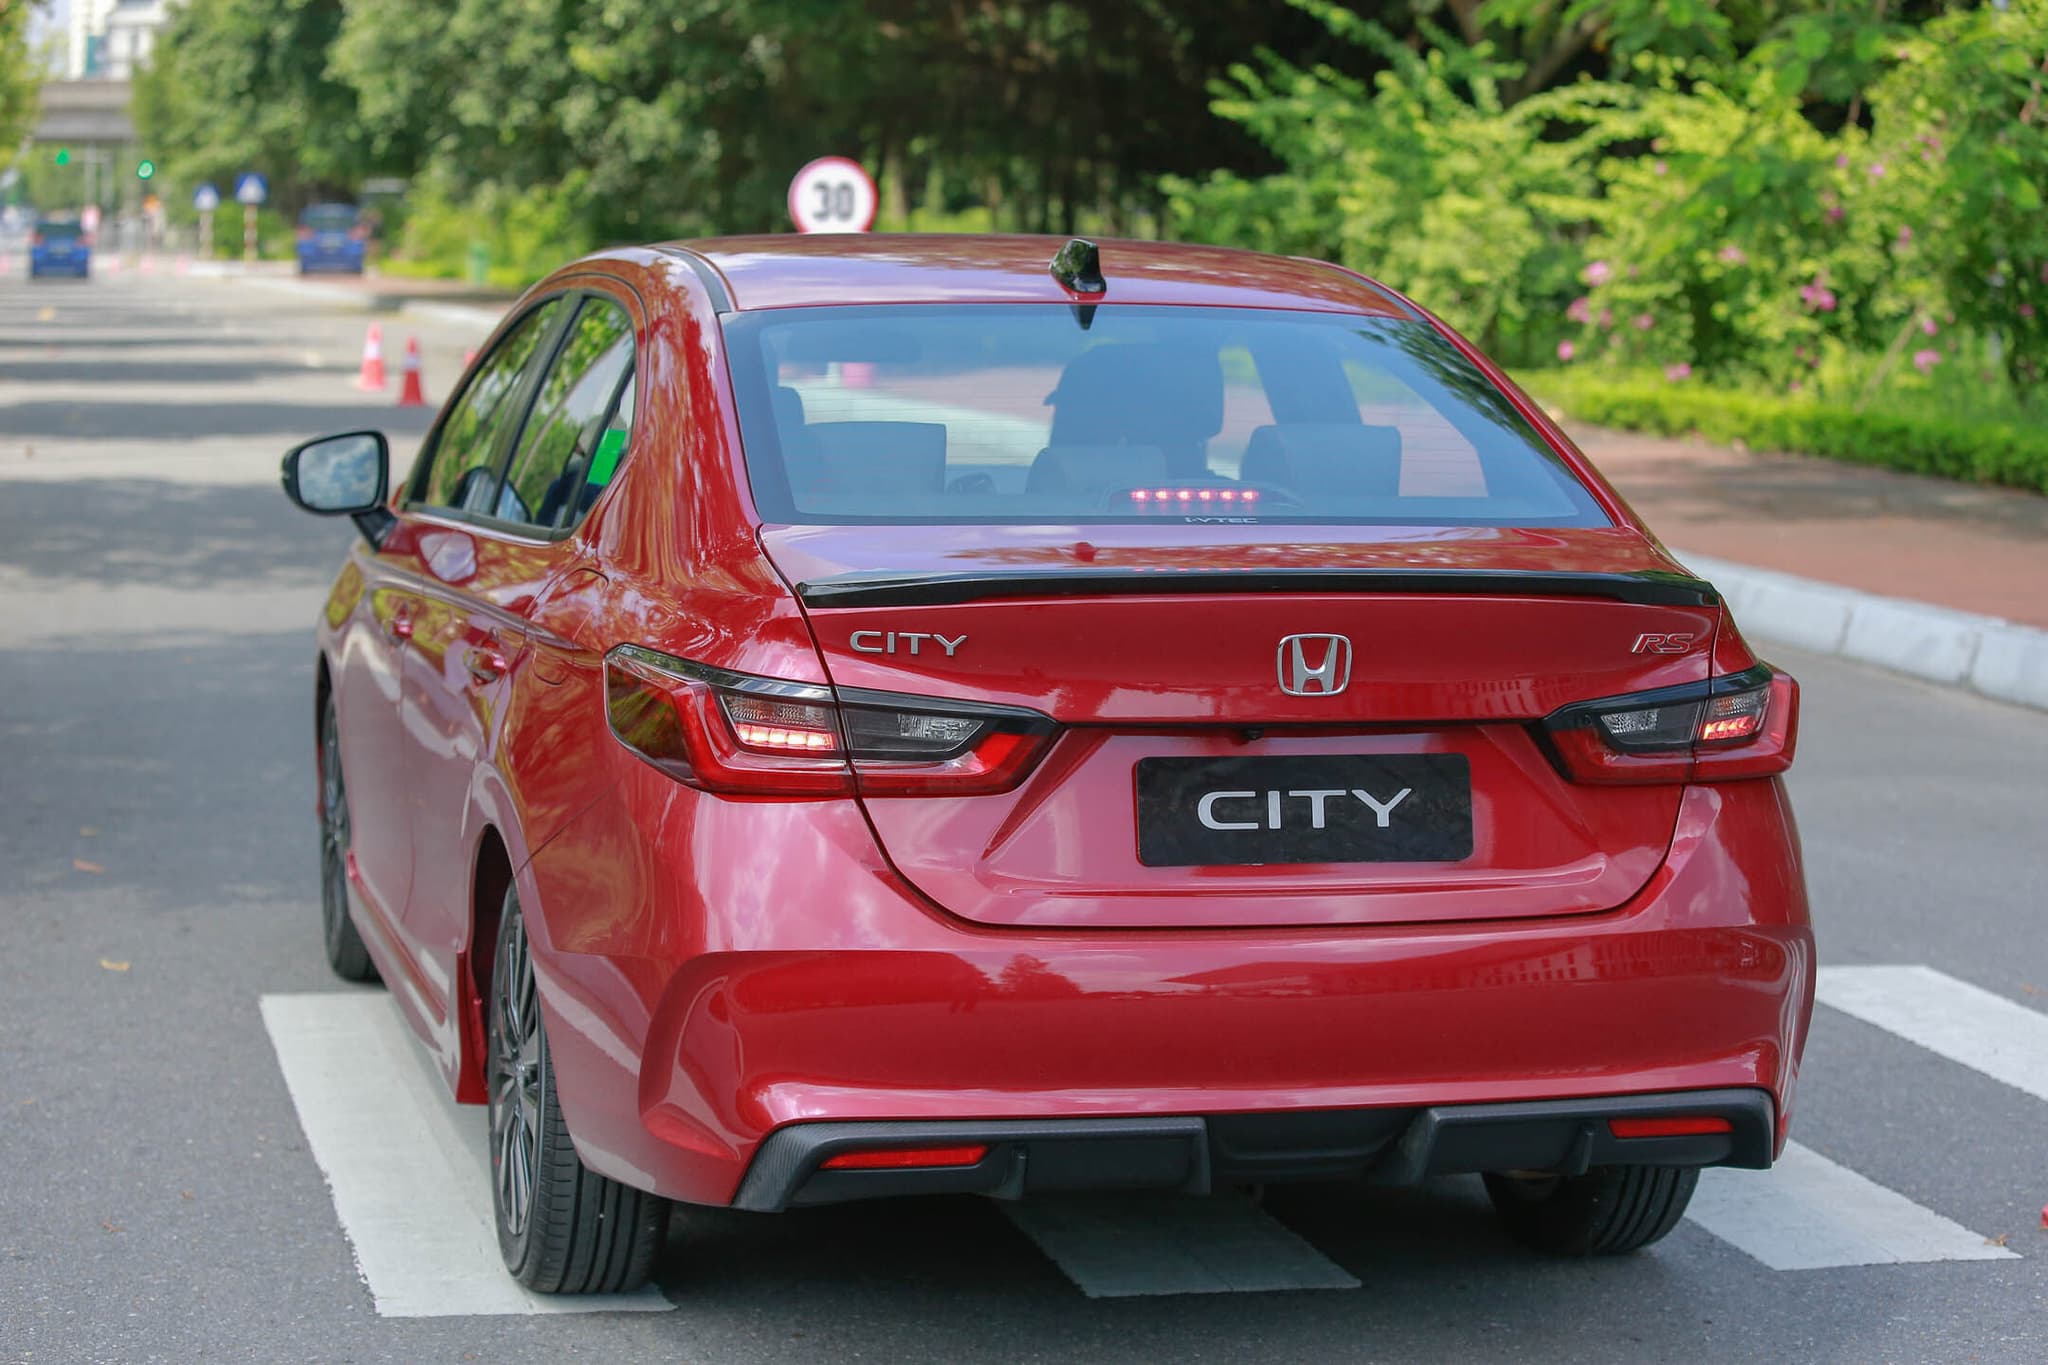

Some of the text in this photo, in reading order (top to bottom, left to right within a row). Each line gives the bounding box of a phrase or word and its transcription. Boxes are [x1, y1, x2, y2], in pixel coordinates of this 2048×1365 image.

[812, 181, 856, 222] 30
[850, 630, 968, 656] CITY
[1631, 633, 1694, 654] RS
[1197, 788, 1412, 830] CITY
